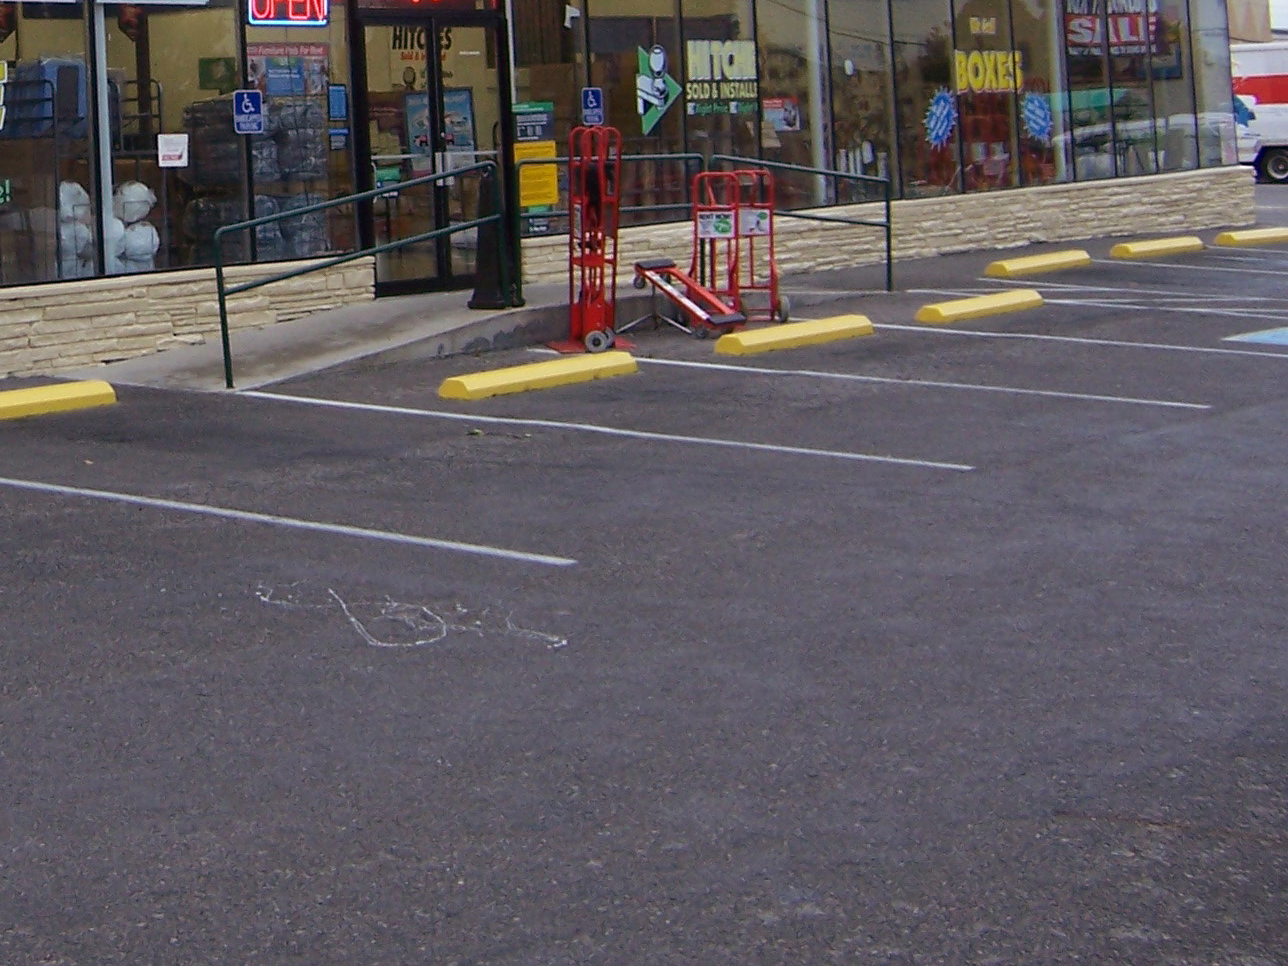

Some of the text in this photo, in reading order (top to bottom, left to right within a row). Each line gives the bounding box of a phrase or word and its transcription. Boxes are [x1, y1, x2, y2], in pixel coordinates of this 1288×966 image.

[392, 26, 452, 50] HITCES
[954, 49, 1023, 94] BOXES
[686, 82, 710, 99] SOLD
